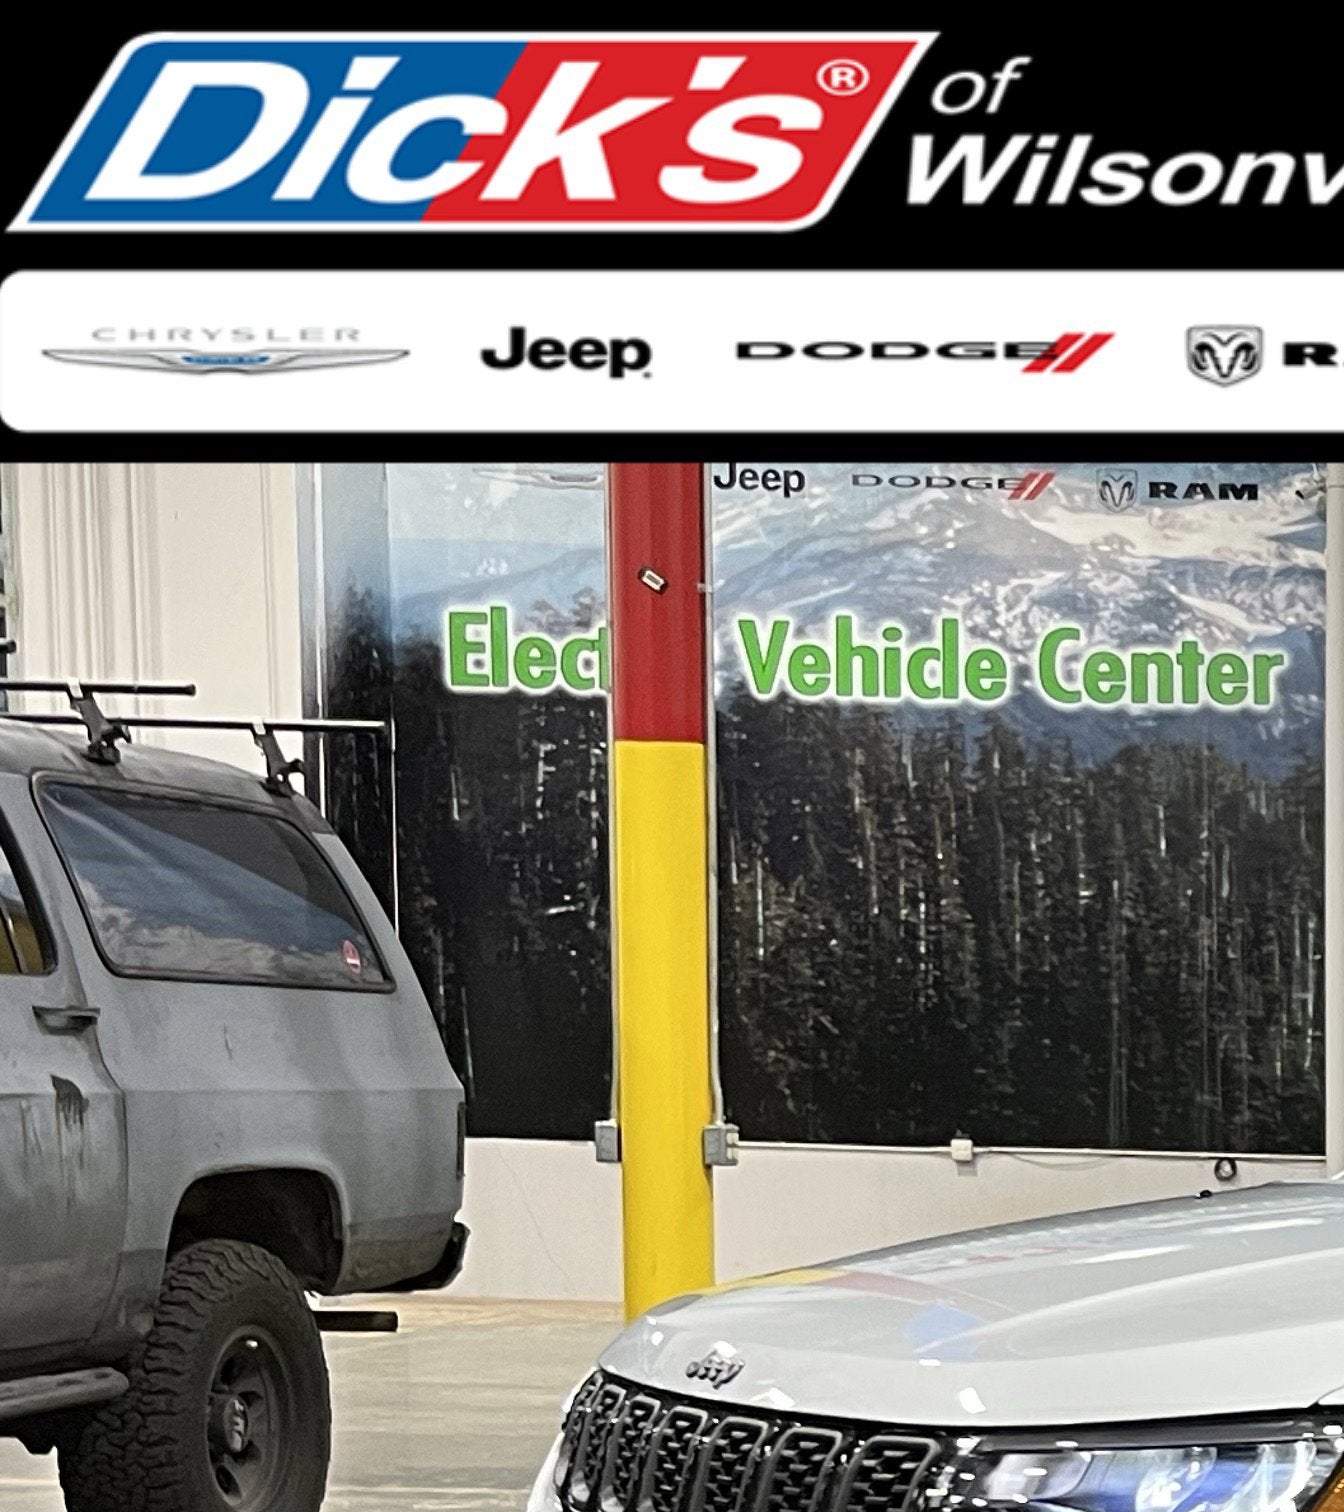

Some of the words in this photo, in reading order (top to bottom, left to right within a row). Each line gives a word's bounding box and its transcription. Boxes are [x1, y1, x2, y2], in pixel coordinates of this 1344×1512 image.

[713, 463, 805, 498] Jeep
[851, 473, 1026, 491] DODGE
[1148, 480, 1258, 501] RAM
[738, 615, 1007, 699] Vehicle
[1039, 627, 1283, 705] Center
